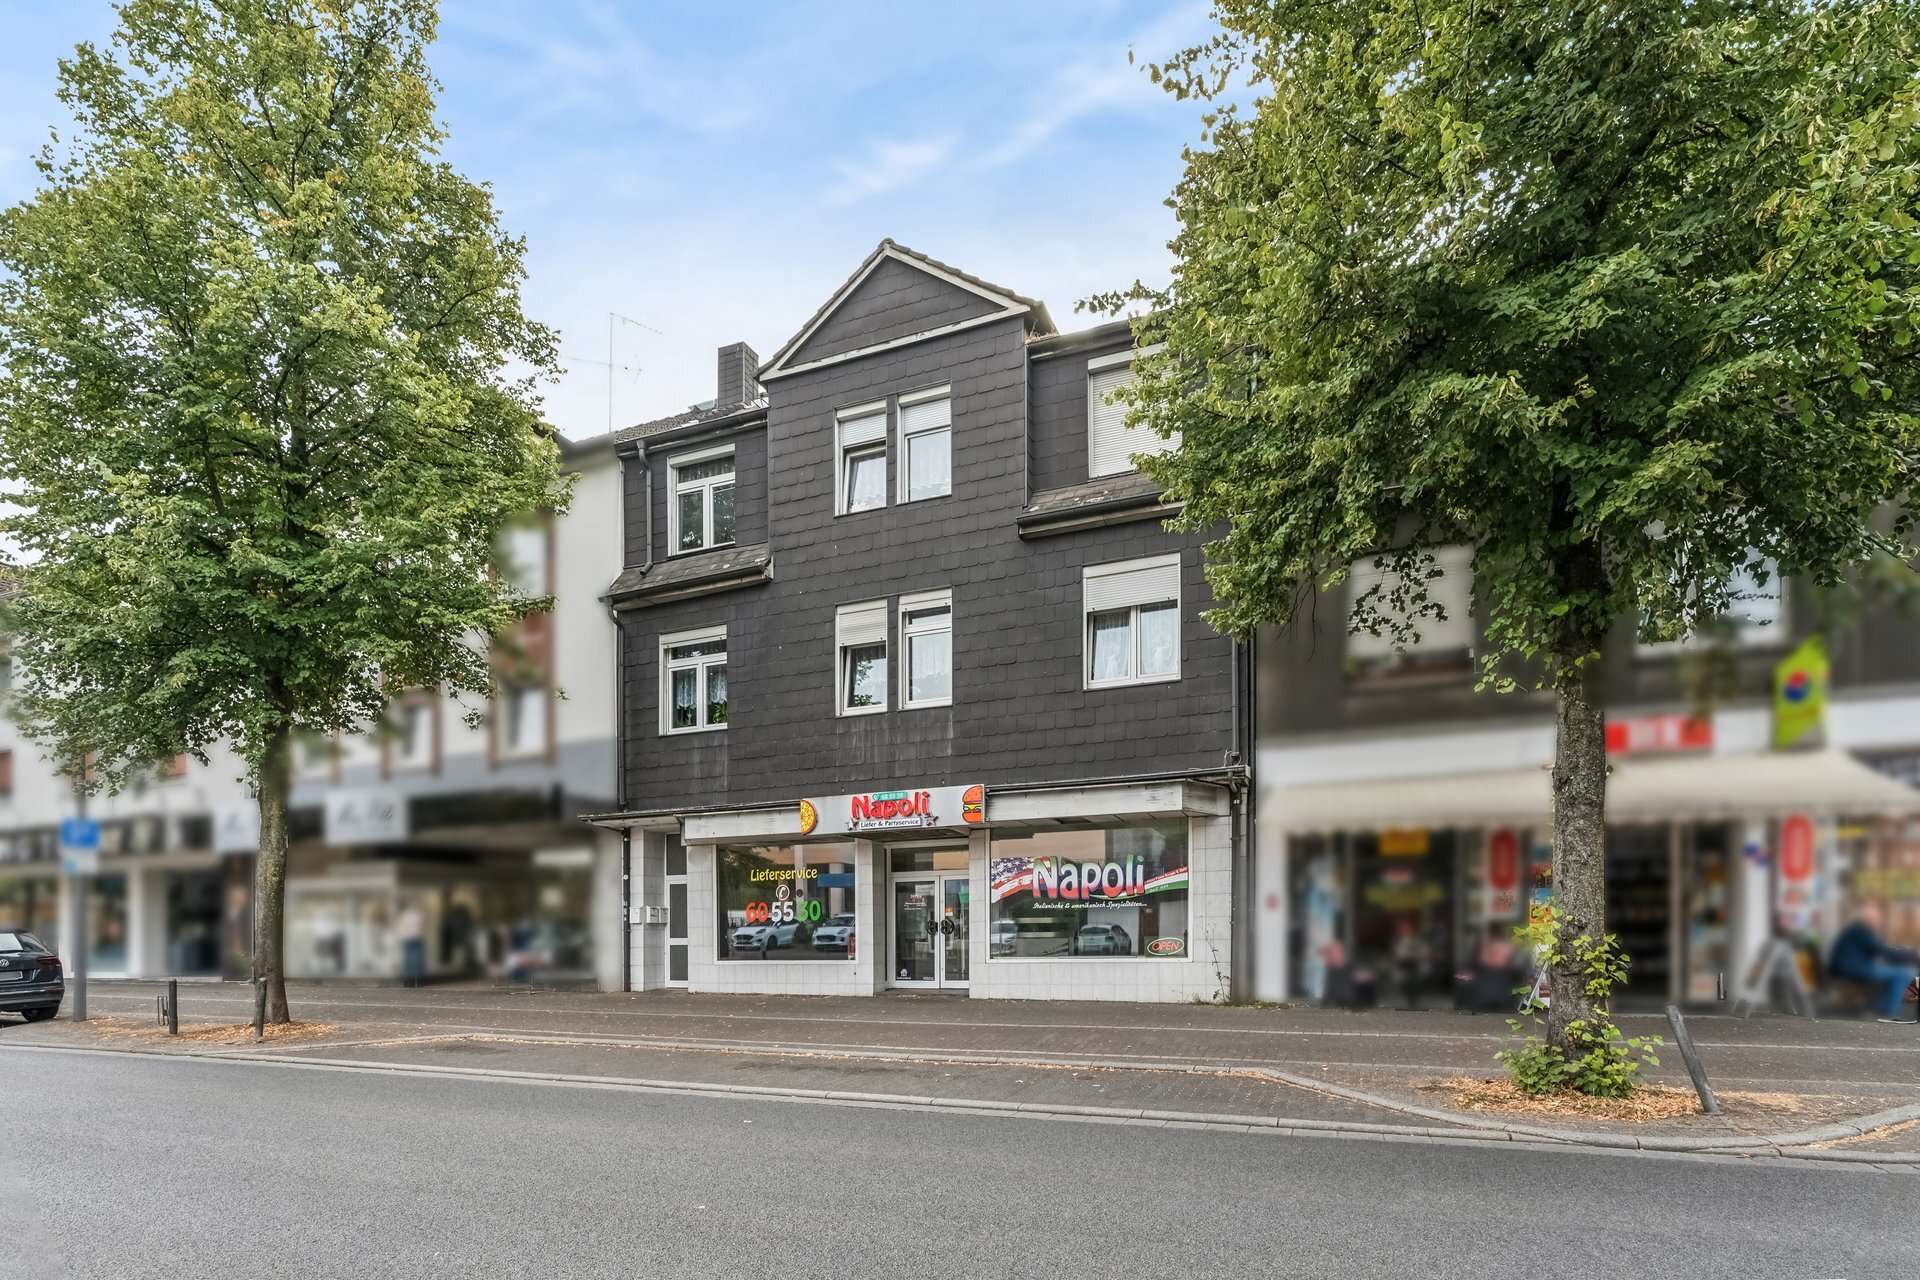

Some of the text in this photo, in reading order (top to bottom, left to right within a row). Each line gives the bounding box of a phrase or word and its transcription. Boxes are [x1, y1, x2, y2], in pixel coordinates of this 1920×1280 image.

[852, 792, 929, 819] Napoli
[750, 868, 817, 881] Lieferservice
[1032, 854, 1145, 900] Napoli
[772, 901, 793, 922] 55
[1152, 941, 1180, 951] OPEN
